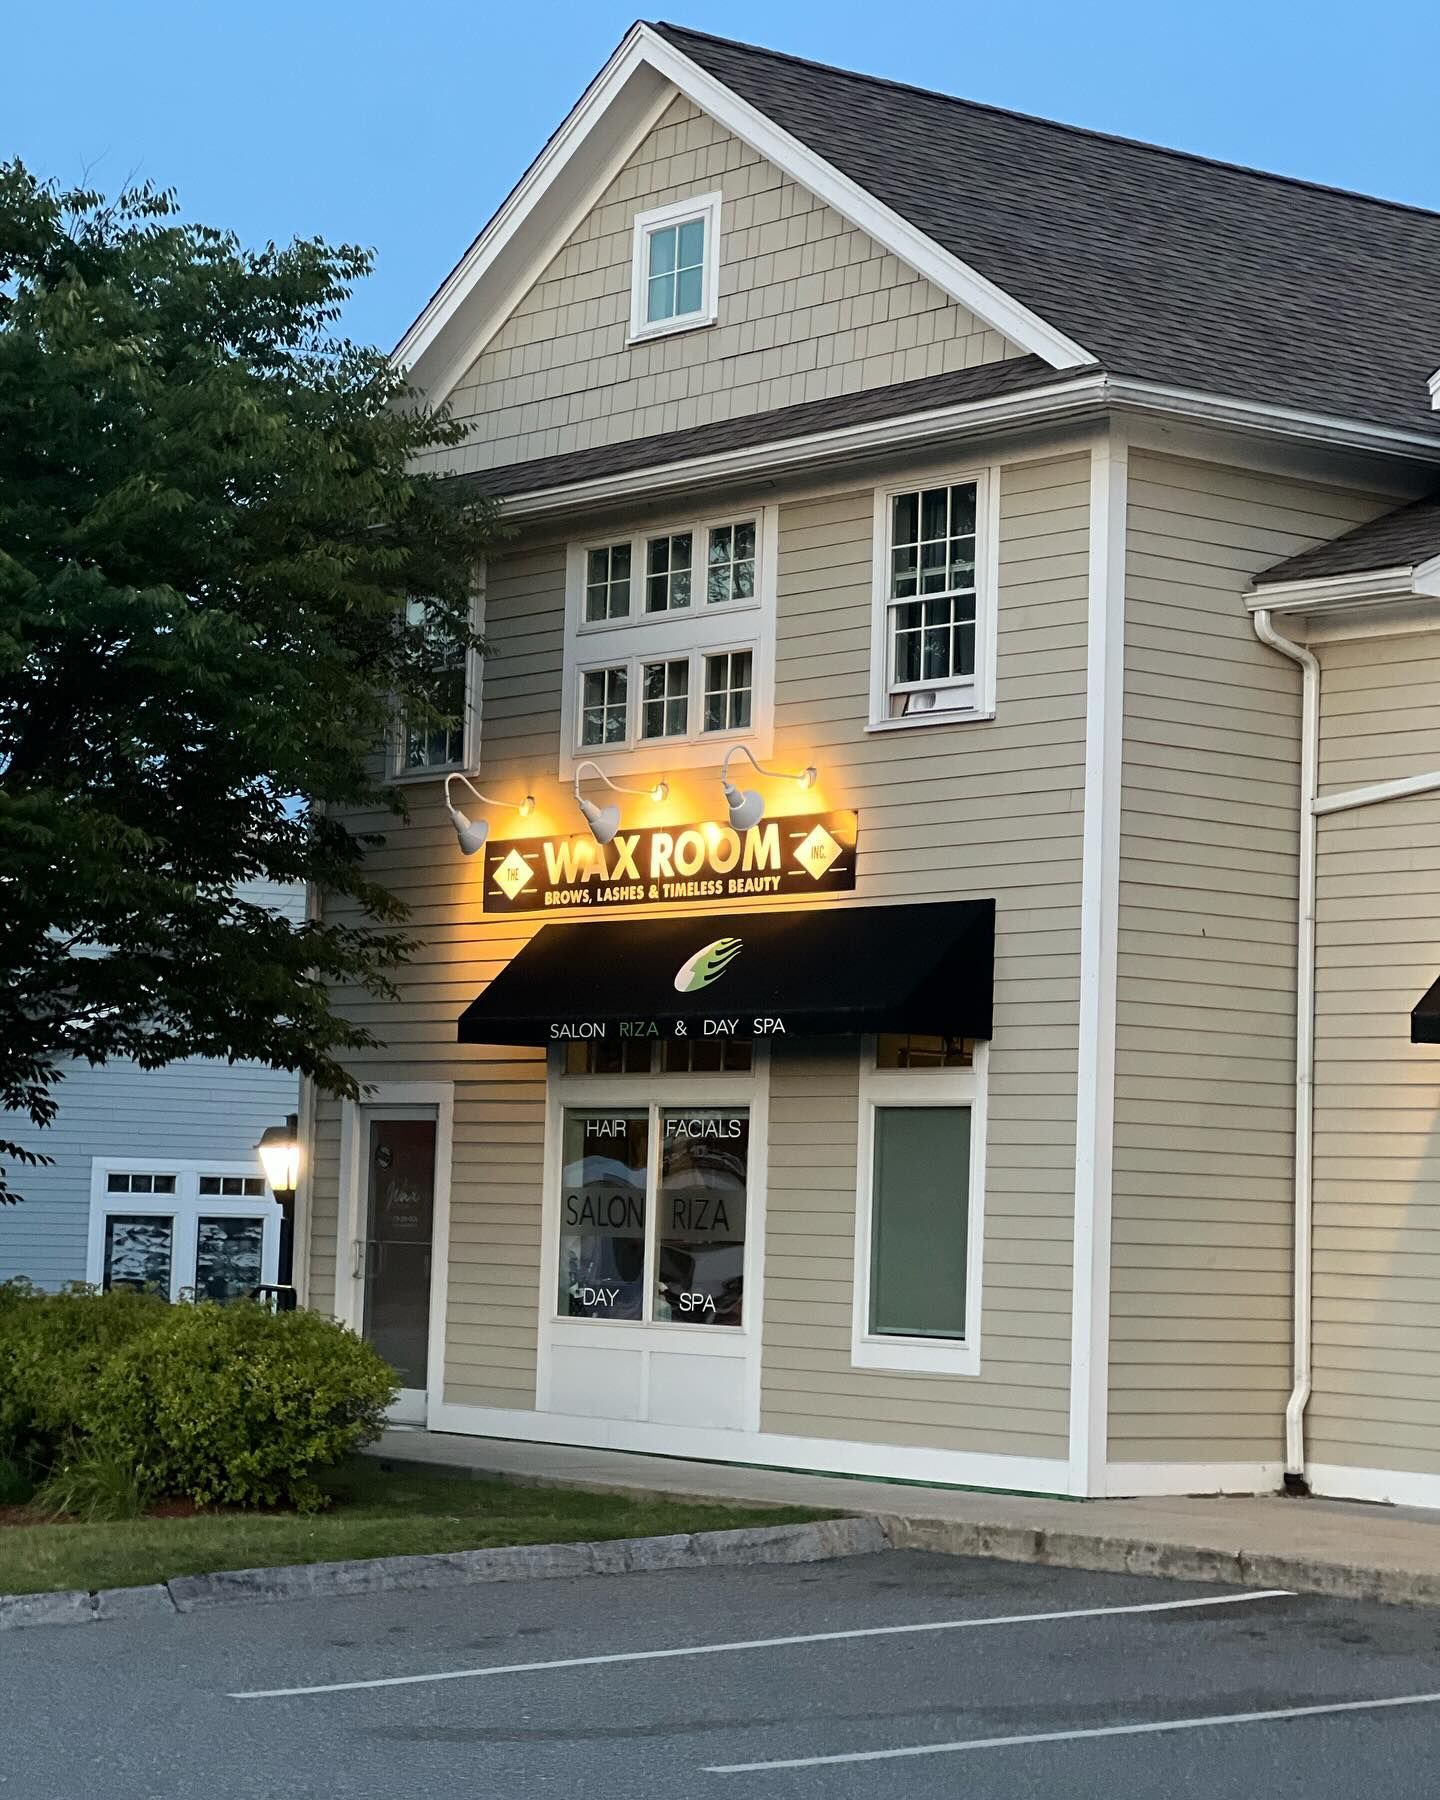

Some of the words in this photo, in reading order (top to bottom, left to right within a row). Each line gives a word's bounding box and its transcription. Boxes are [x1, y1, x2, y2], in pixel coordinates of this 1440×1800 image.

[507, 868, 519, 881] THE
[543, 834, 641, 885] WAX
[650, 823, 782, 878] ROOM
[811, 846, 827, 860] INC.
[544, 889, 593, 906] BROWS,
[596, 885, 645, 902] LASHES
[648, 884, 659, 899] &
[663, 880, 724, 898] TIMELESS
[728, 876, 782, 894] BEAUTY
[550, 1022, 606, 1039] SALON
[619, 1021, 660, 1037] RIZA
[674, 1020, 688, 1036] &
[703, 1018, 740, 1035] DAY
[753, 1017, 786, 1035] SPA
[586, 1119, 627, 1138] HAIR
[666, 1119, 742, 1138] FACIALS
[566, 1195, 644, 1229] SALON
[672, 1198, 730, 1233] RIZA
[583, 1287, 620, 1307] DAY
[679, 1292, 717, 1313] SPA
